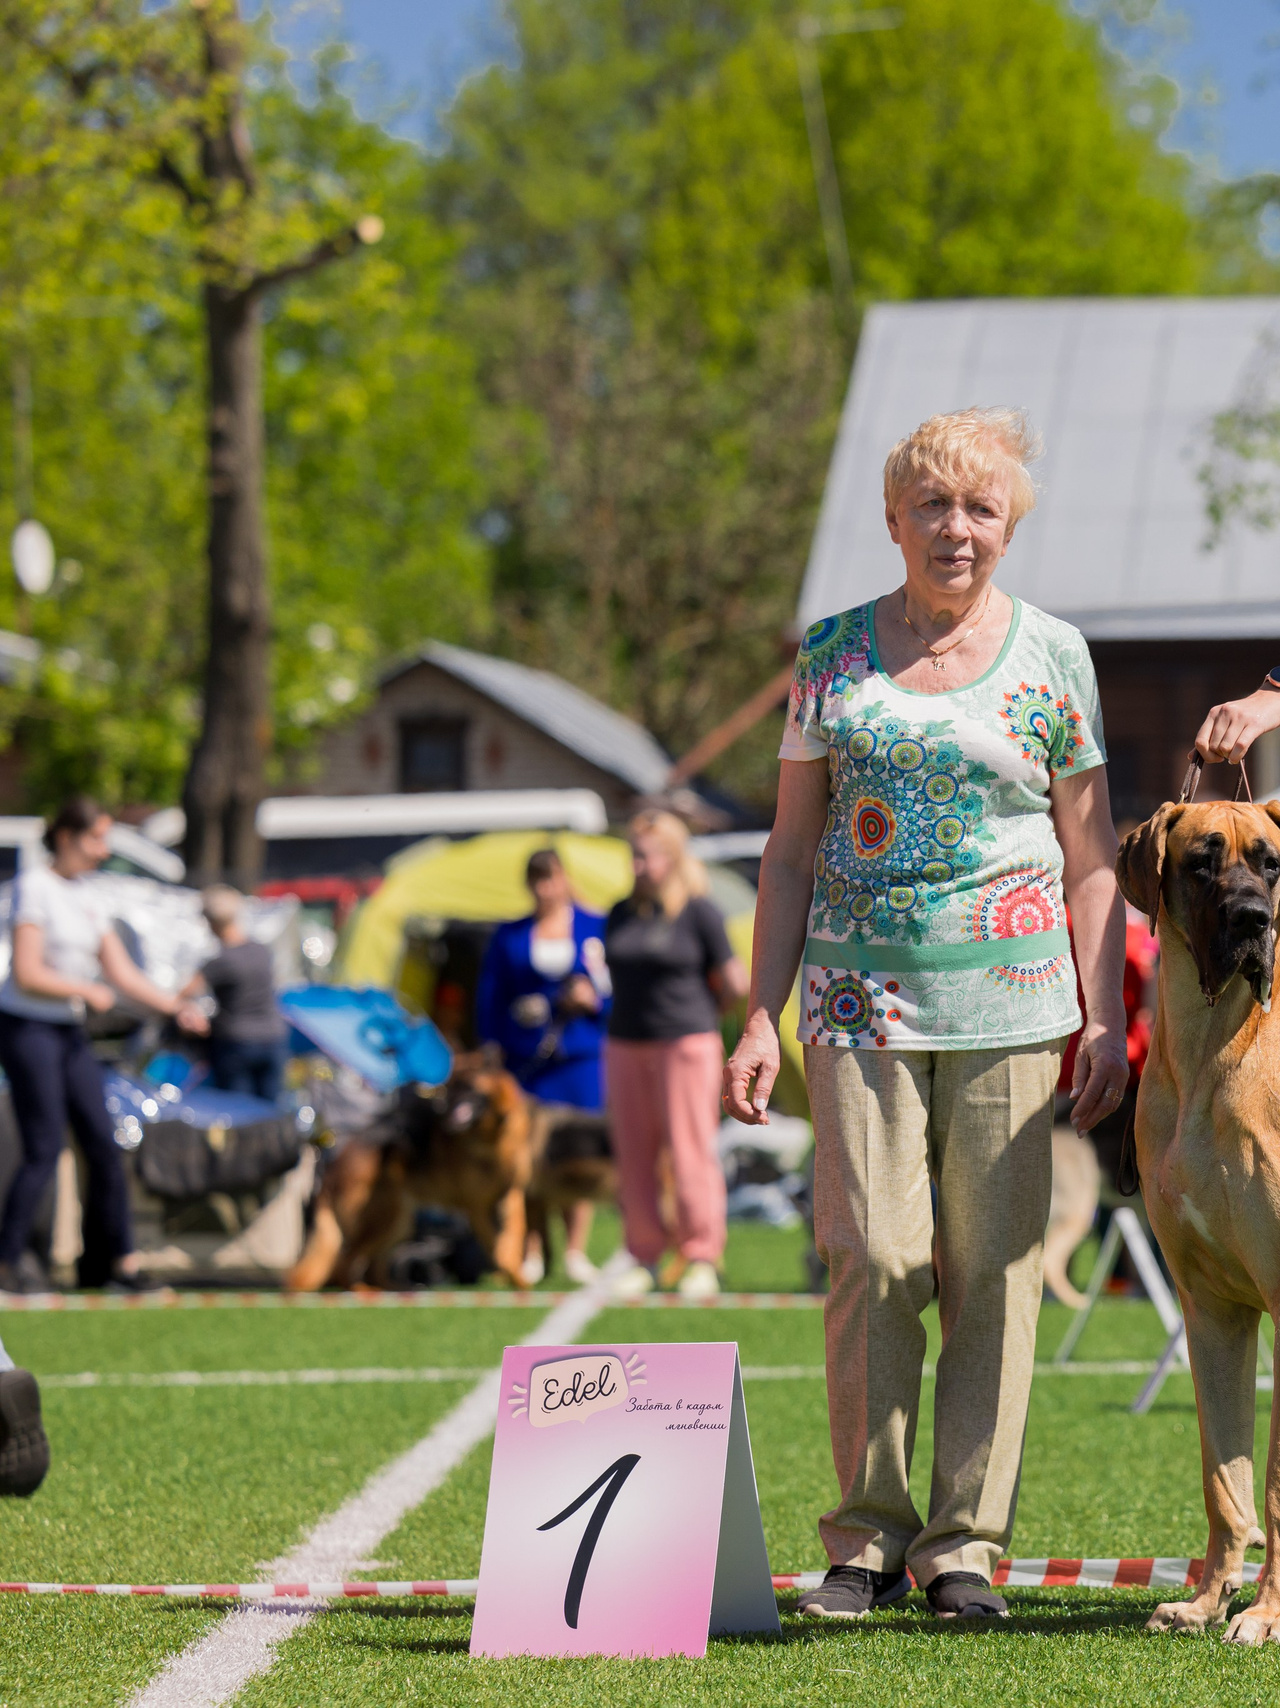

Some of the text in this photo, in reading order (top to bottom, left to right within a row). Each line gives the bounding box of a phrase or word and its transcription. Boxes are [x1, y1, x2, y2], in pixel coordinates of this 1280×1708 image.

[543, 1364, 617, 1411] Edel
[625, 1396, 725, 1416] Забота в кадом
[665, 1418, 728, 1431] мгновении
[535, 1453, 642, 1630] 1
